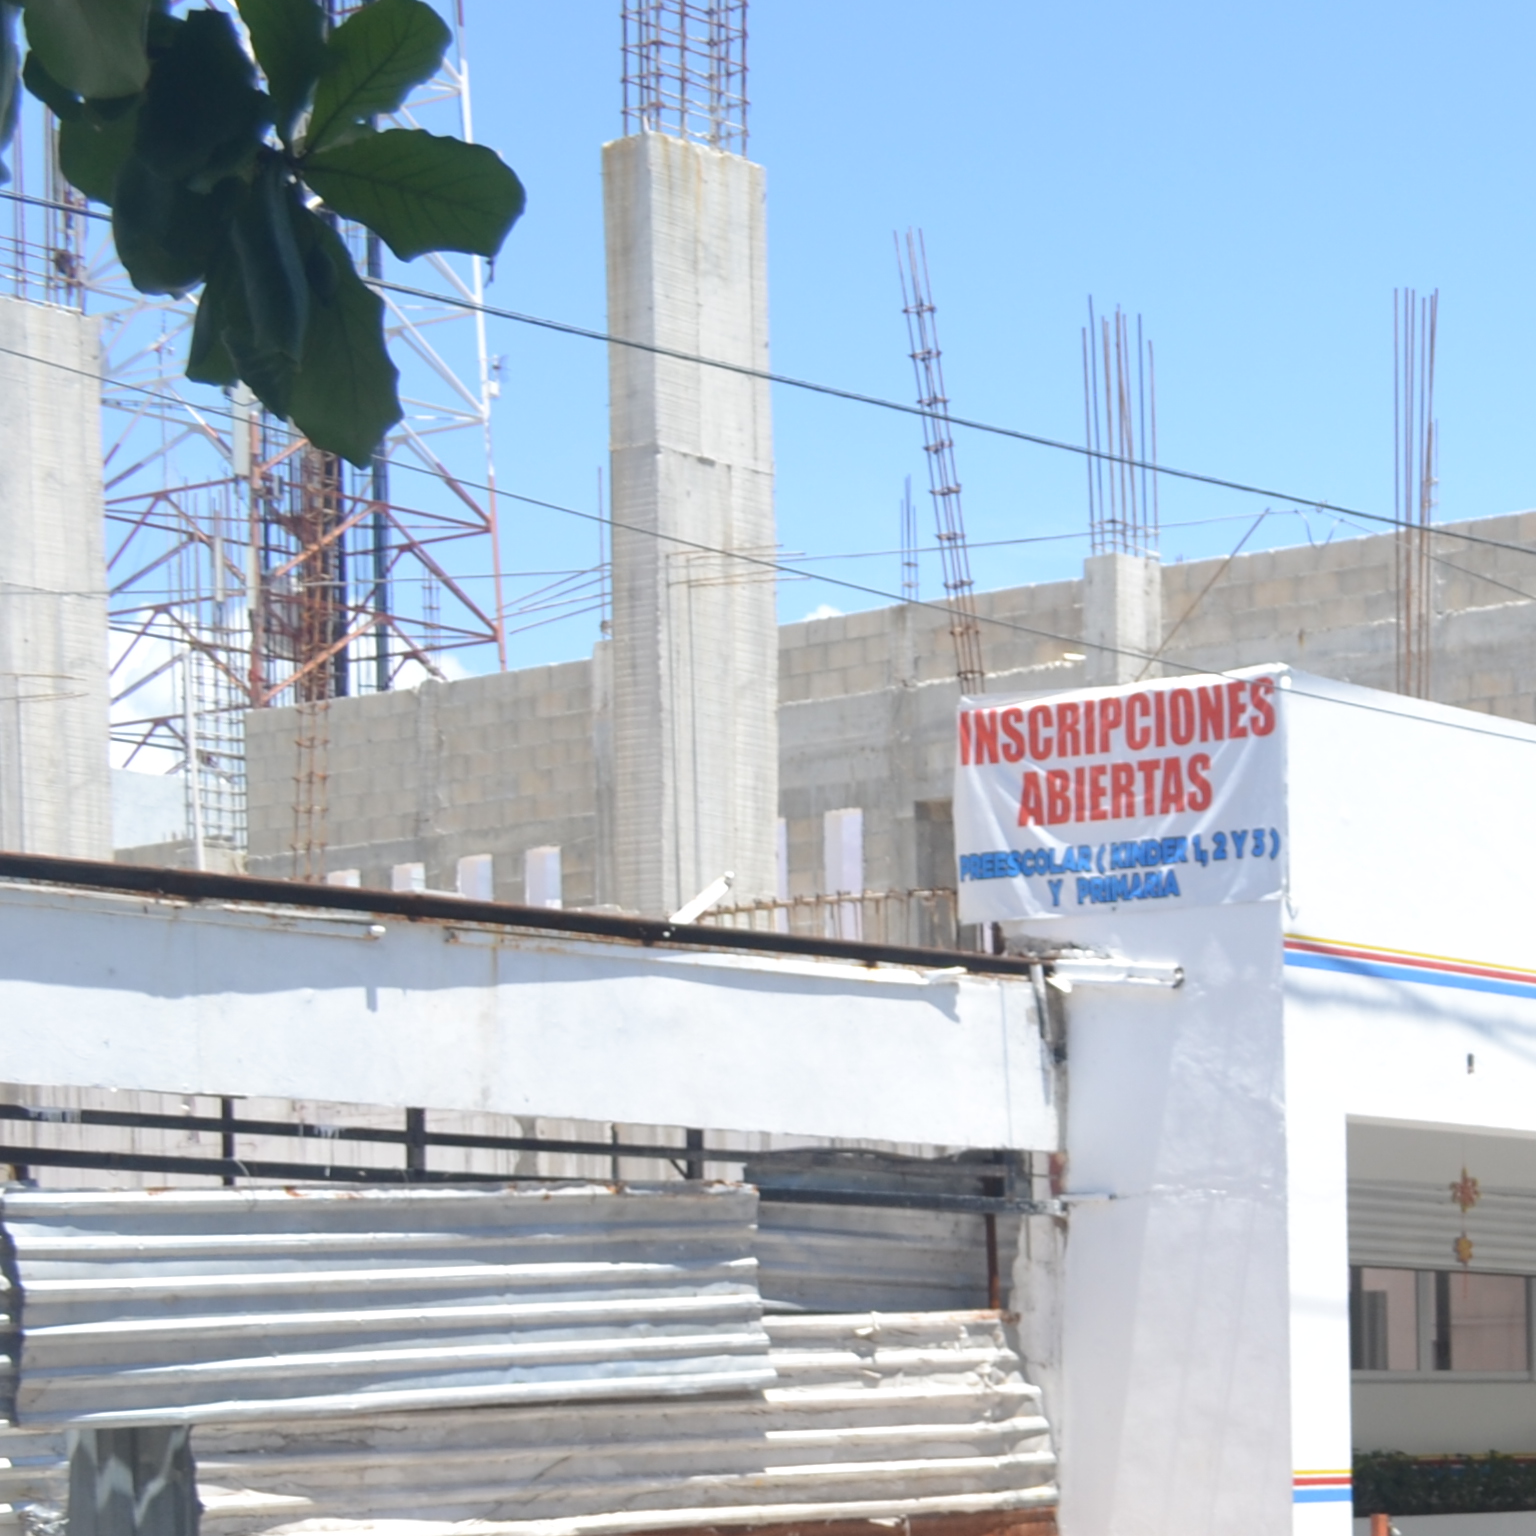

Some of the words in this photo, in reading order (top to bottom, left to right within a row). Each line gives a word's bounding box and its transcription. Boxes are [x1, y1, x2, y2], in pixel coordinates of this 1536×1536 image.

[960, 676, 1276, 766] INSCRIPCIONES
[1018, 752, 1213, 828] ABIERTAS
[960, 844, 1092, 882] PREESCOLAR
[1212, 831, 1228, 860] 2
[1230, 829, 1249, 859] Y
[1251, 828, 1266, 857] 3
[1047, 878, 1064, 907] Y
[1076, 868, 1181, 905] PRIMARIA
